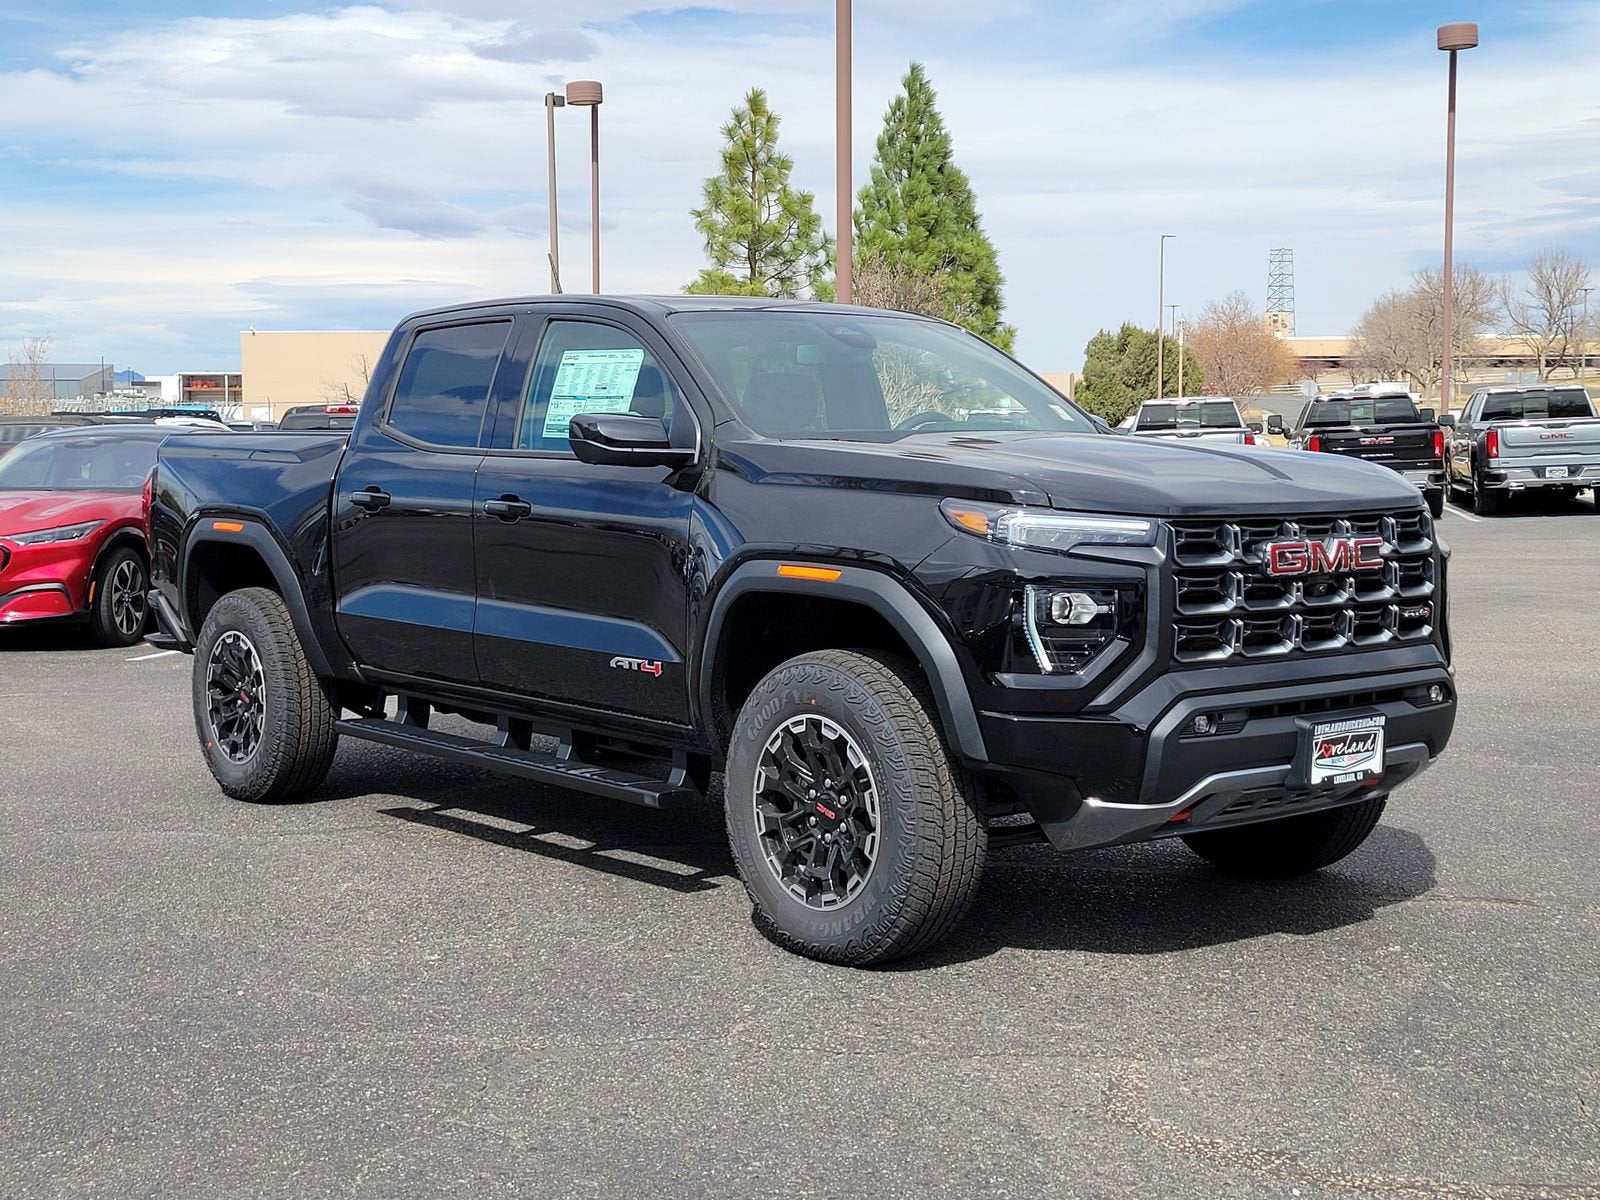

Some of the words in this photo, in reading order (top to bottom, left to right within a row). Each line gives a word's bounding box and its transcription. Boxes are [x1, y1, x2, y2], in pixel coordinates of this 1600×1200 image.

[1359, 437, 1394, 445] GMC
[1266, 537, 1384, 575] GMC
[609, 656, 663, 677] AT4
[1313, 734, 1374, 759] Loveland
